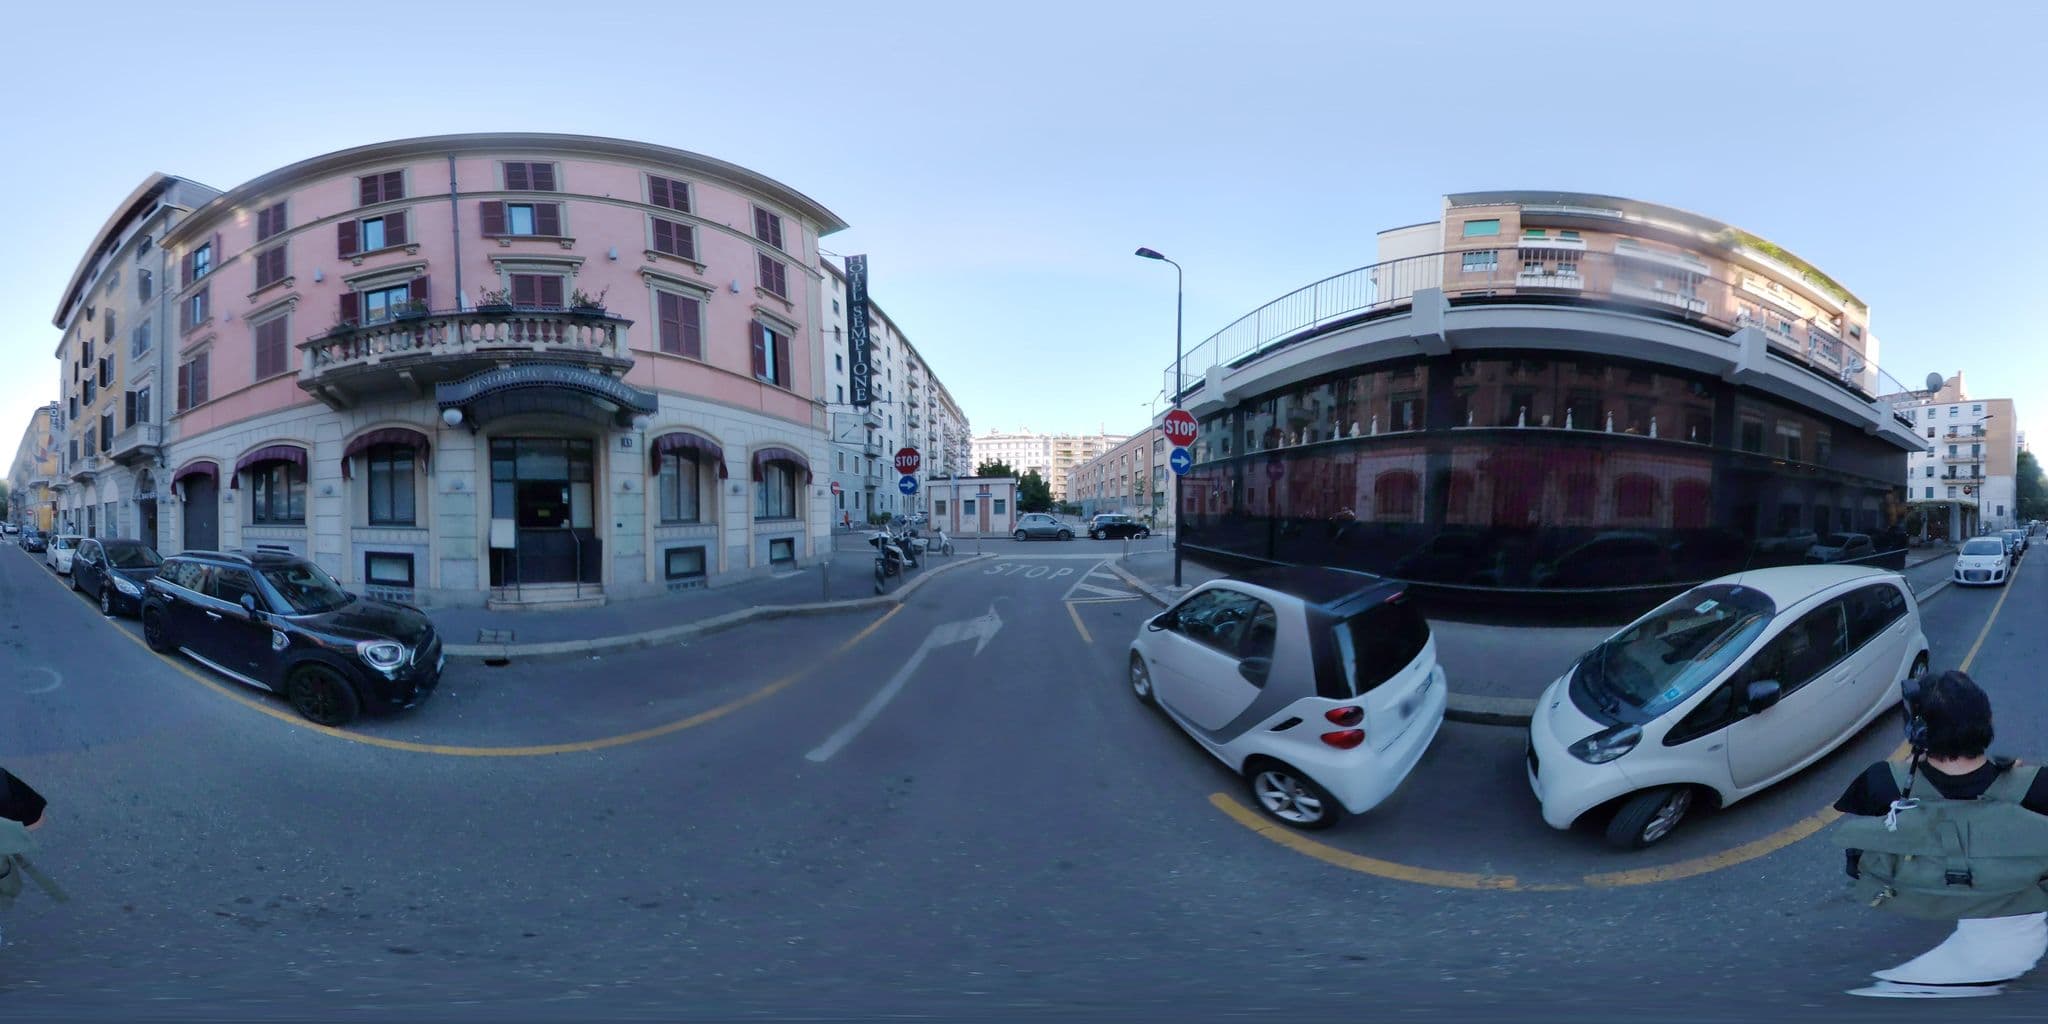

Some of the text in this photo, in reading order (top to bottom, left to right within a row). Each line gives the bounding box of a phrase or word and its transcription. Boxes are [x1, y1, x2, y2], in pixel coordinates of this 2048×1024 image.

[848, 255, 868, 401] HOTEL SEMPIONE
[1165, 420, 1195, 436] STOP
[895, 455, 919, 467] STOP
[983, 563, 1075, 579] STOP
